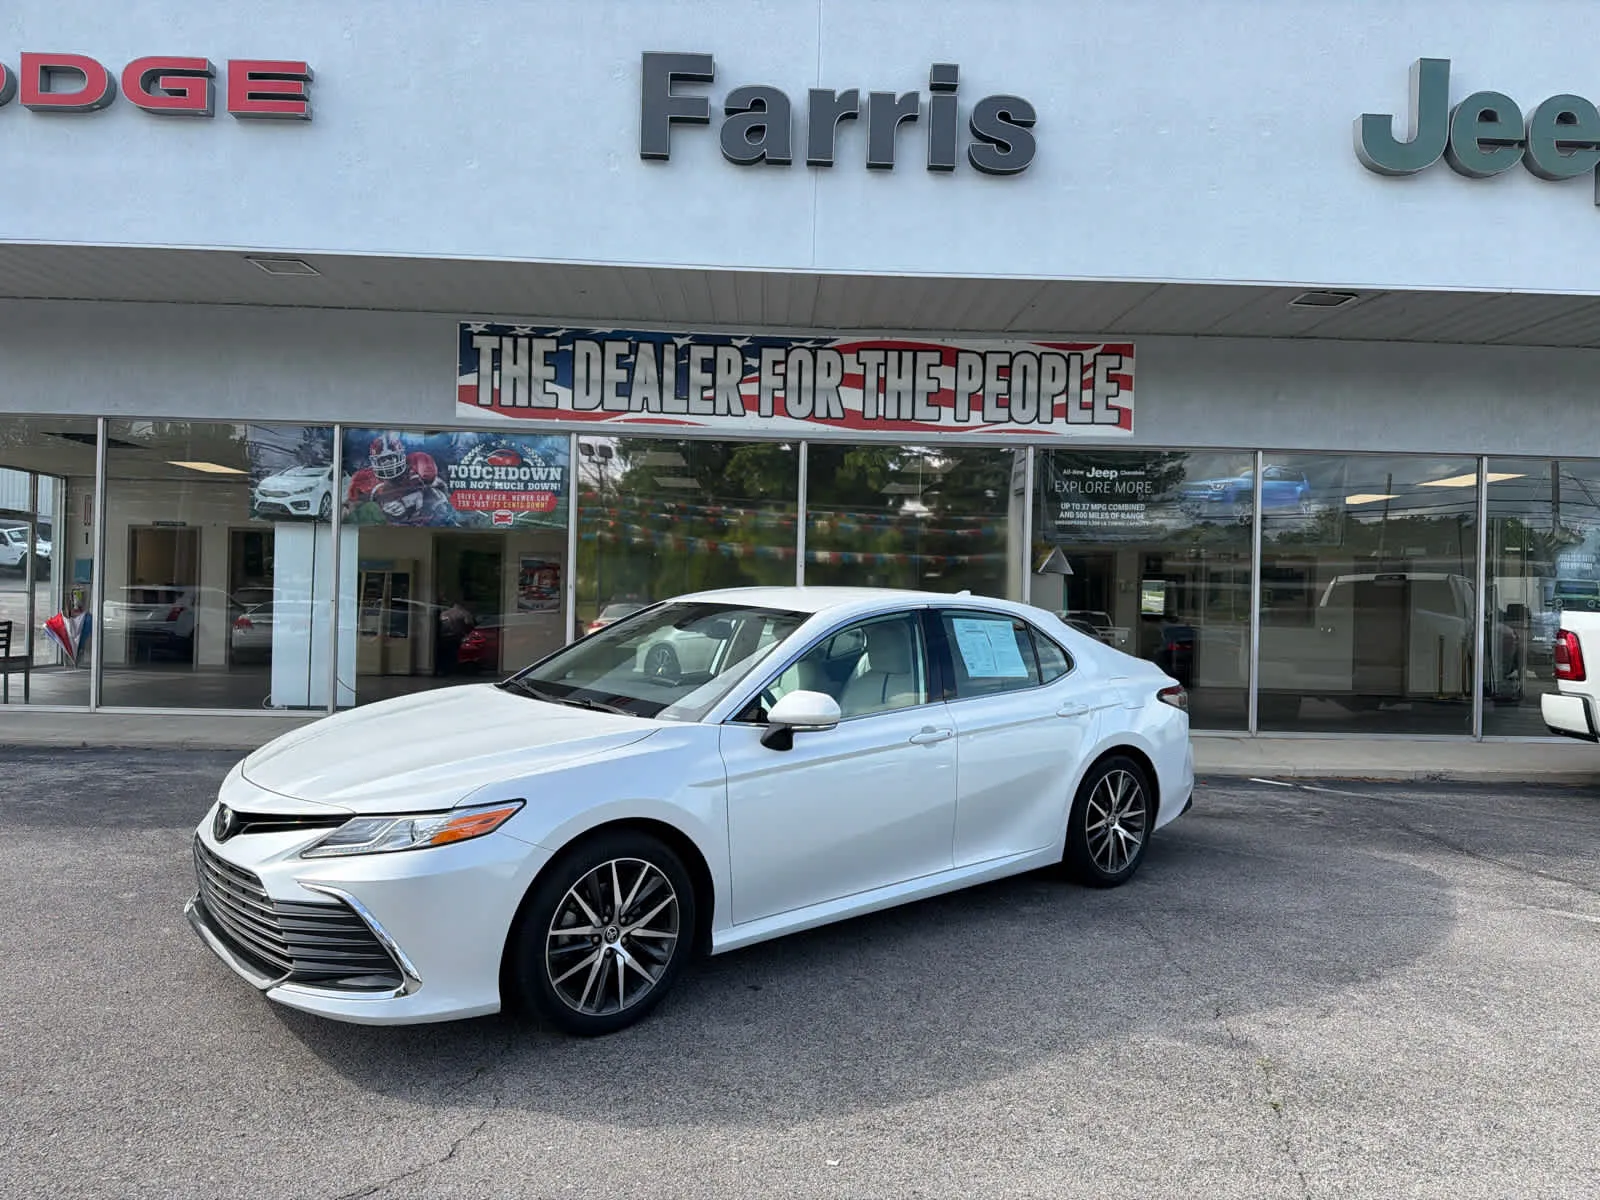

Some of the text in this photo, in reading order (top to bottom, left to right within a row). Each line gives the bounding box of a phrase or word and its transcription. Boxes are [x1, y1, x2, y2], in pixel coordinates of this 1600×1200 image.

[0, 52, 313, 121] DGE
[639, 50, 1037, 176] Farris
[1352, 57, 1600, 206] Jee
[471, 333, 1125, 425] THE DEALER FOR THE PEOPLE
[448, 465, 562, 481] TOUCHDOWN
[1086, 466, 1118, 480] Jeep
[449, 480, 561, 491] FOR NOT MUCH DOWN!
[1055, 480, 1153, 495] EXPLORE MORE
[1060, 502, 1071, 510] UP
[1072, 503, 1080, 511] TO
[1090, 503, 1107, 511] MPG
[1107, 503, 1146, 511] COMBINED
[1059, 511, 1145, 520] AND 500 MILES OF RANGE
